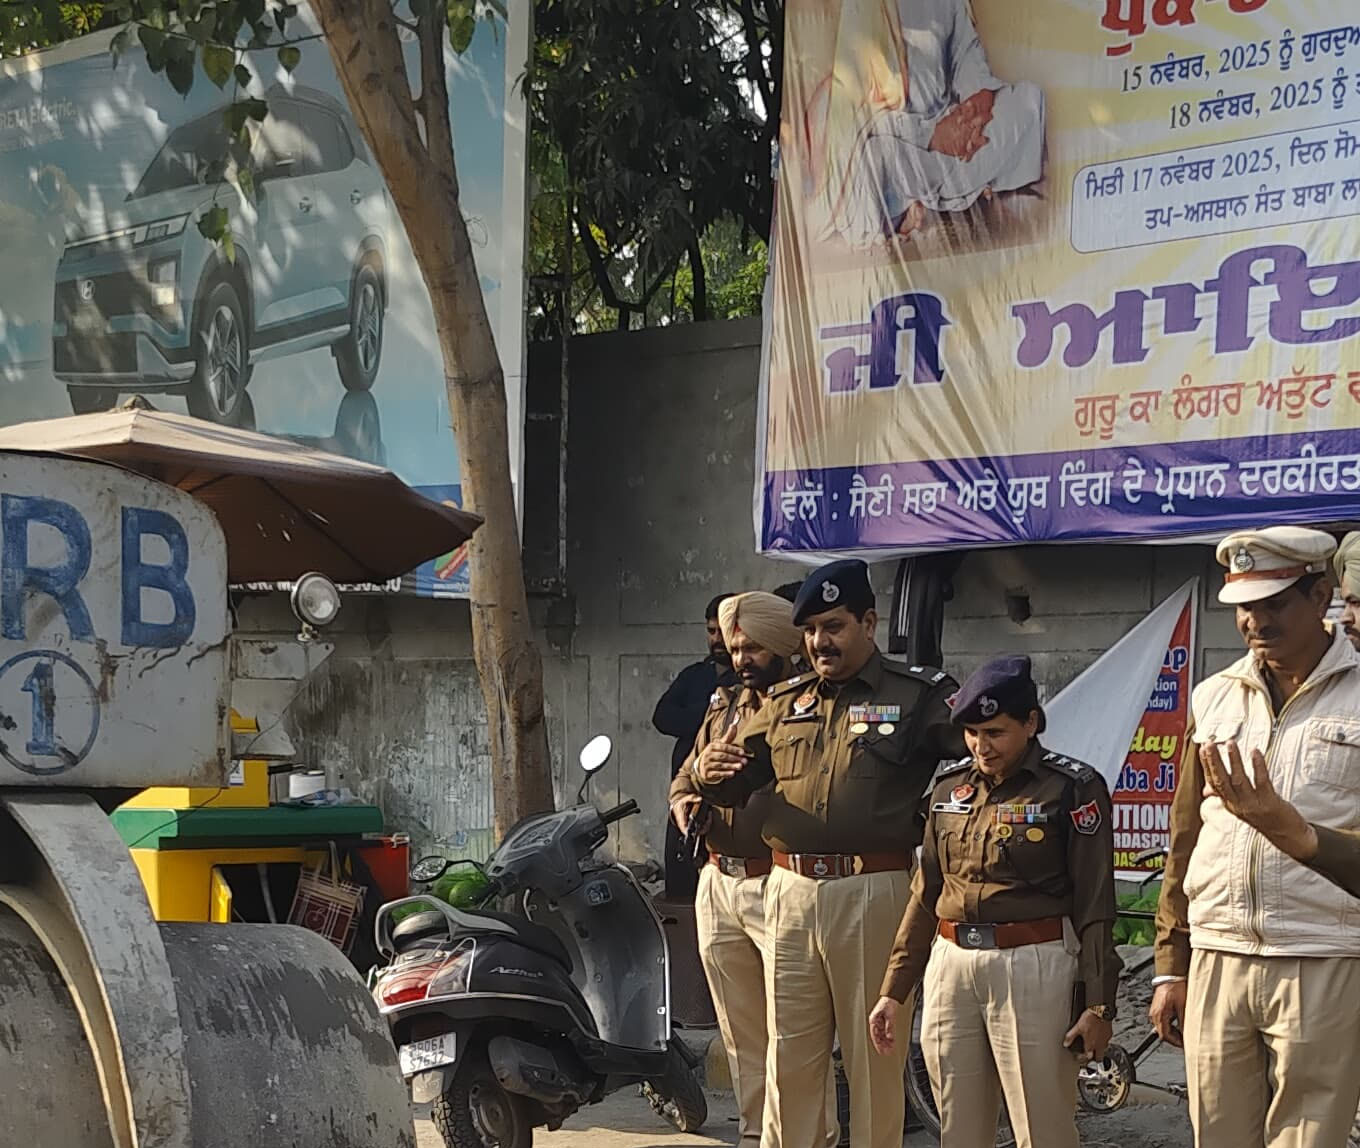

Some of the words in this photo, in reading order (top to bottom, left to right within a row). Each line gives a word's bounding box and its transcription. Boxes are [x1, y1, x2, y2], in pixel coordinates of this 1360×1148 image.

[1122, 65, 1142, 93] 15
[1150, 52, 1211, 85] ਨਵੰਬਰ,
[1218, 40, 1271, 74] 2025
[1279, 29, 1295, 70] ਨੂੰ
[1169, 103, 1191, 129] 18
[1198, 90, 1260, 122] ਨਵੰਬਰ,
[1270, 79, 1323, 112] 2025
[1332, 68, 1347, 108] ਨੂੰ
[1086, 166, 1123, 199] ਮਿਤੀ
[1132, 163, 1152, 193] 17
[1159, 156, 1215, 189] ਨਵੰਬਰ
[1222, 149, 1281, 178] 2025,
[1290, 137, 1327, 167] ਦਿਨ
[1255, 184, 1286, 214] ਸੰਤ
[1292, 182, 1335, 208] ਬਾਬਾ
[820, 292, 953, 393] ਜੀ
[1075, 394, 1120, 440] ਗੁਰੂ
[1129, 390, 1161, 424] ਕਾ
[1172, 374, 1245, 421] ਲੰਗਰ
[849, 473, 895, 518] ਸੈਣੀ
[902, 481, 949, 515] ਸਭਾ
[956, 468, 1000, 512] ਅਤੇ
[1059, 459, 1114, 508] ਵਿੰਗ
[1122, 458, 1146, 504] ਦੇ
[1154, 463, 1230, 514] ਪ੍ਰਧਾਨ
[1154, 764, 1176, 792] Ji
